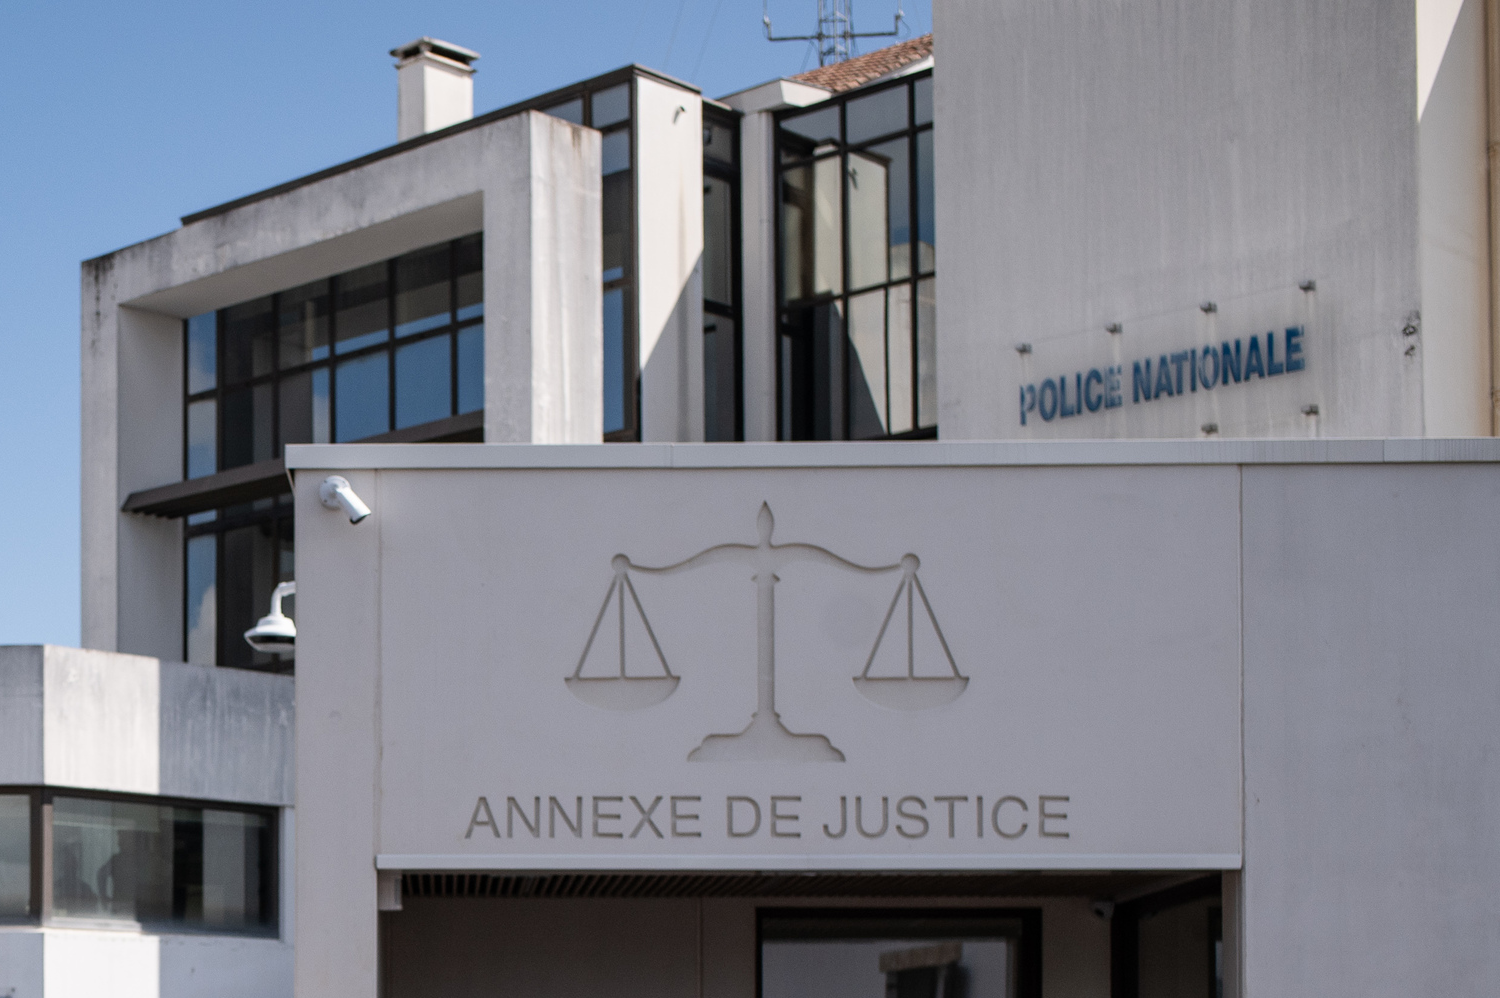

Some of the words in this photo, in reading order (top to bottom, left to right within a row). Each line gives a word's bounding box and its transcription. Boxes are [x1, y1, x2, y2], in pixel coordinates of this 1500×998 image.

[1019, 367, 1123, 427] POLICE
[1133, 325, 1306, 404] NATIONALE
[465, 795, 702, 839] ANNEXE
[726, 795, 802, 839] DE
[822, 795, 1070, 840] JUSTICE
